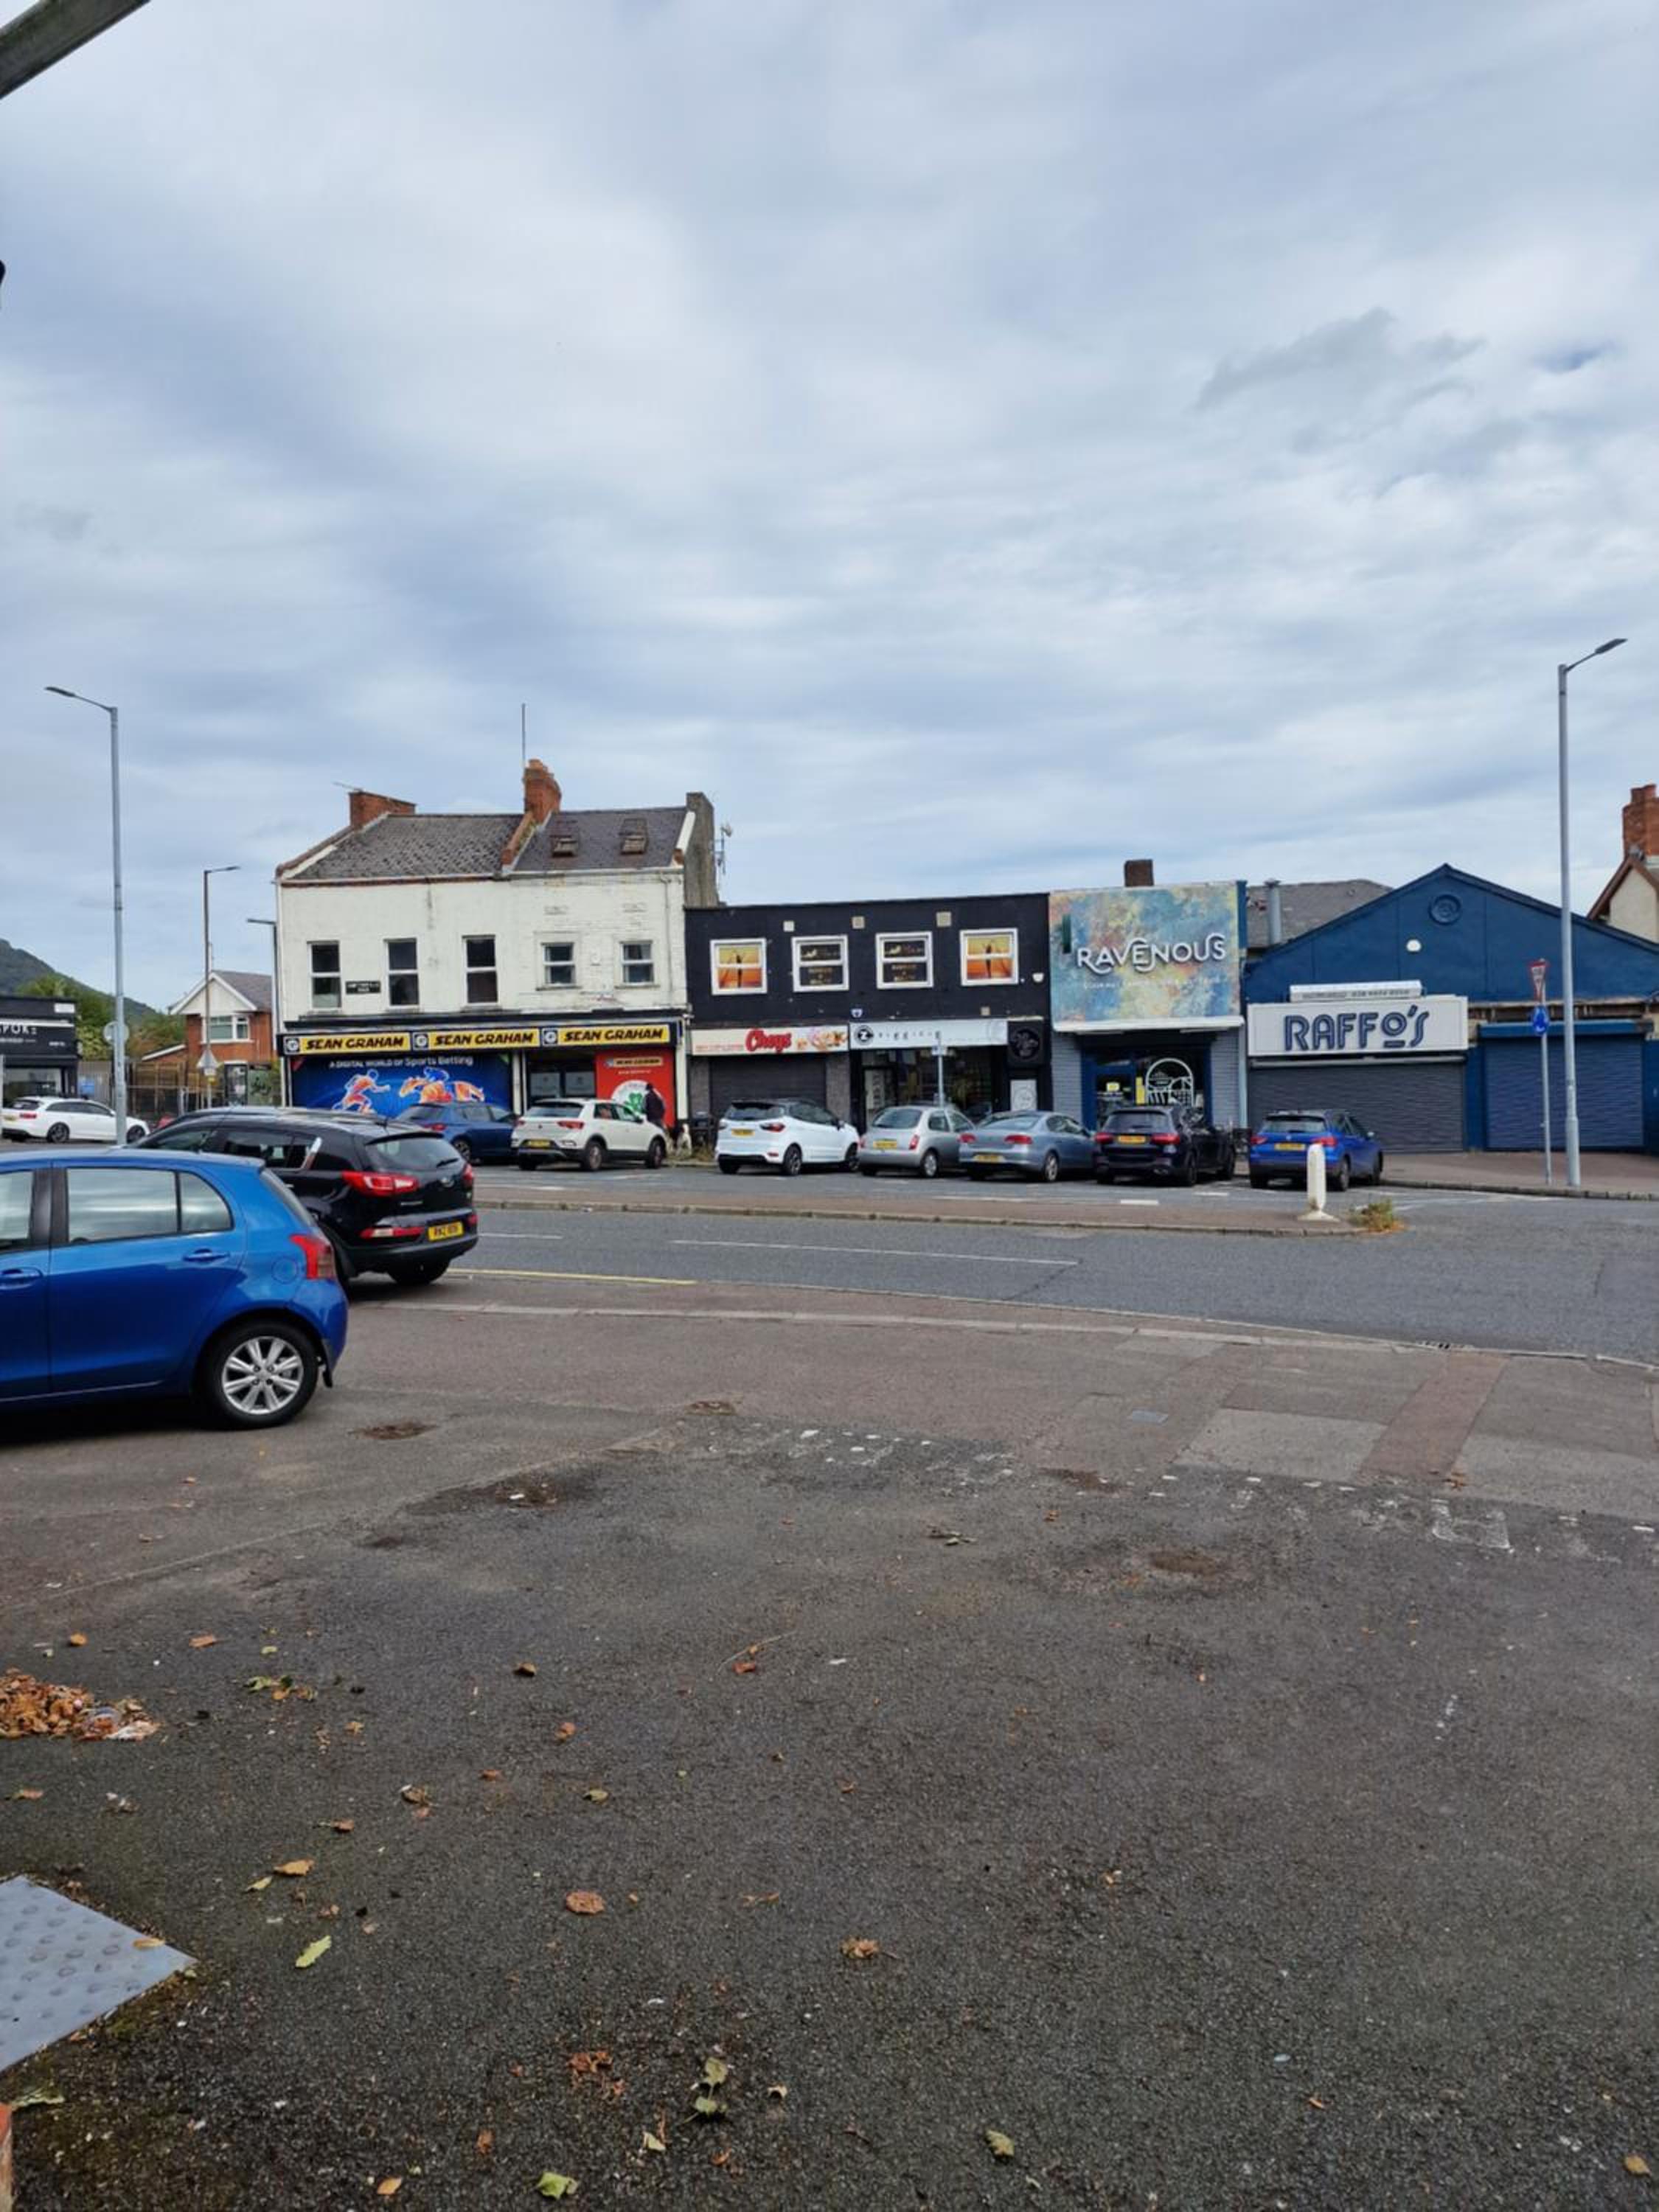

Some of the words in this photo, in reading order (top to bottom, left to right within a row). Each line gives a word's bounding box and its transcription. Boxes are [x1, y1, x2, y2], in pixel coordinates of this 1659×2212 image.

[1077, 933, 1227, 974] RAVENOUS
[1284, 1004, 1430, 1051] RAFFO'S
[435, 1034, 471, 1046] SEAN
[474, 1032, 533, 1044] GRAHAM
[564, 1031, 601, 1042] SEAN
[604, 1028, 664, 1040] GRAHAM
[306, 1038, 341, 1050] SEAN
[345, 1037, 404, 1048] GRAHAM
[405, 1057, 437, 1068] Sports
[438, 1056, 473, 1067] Betting
